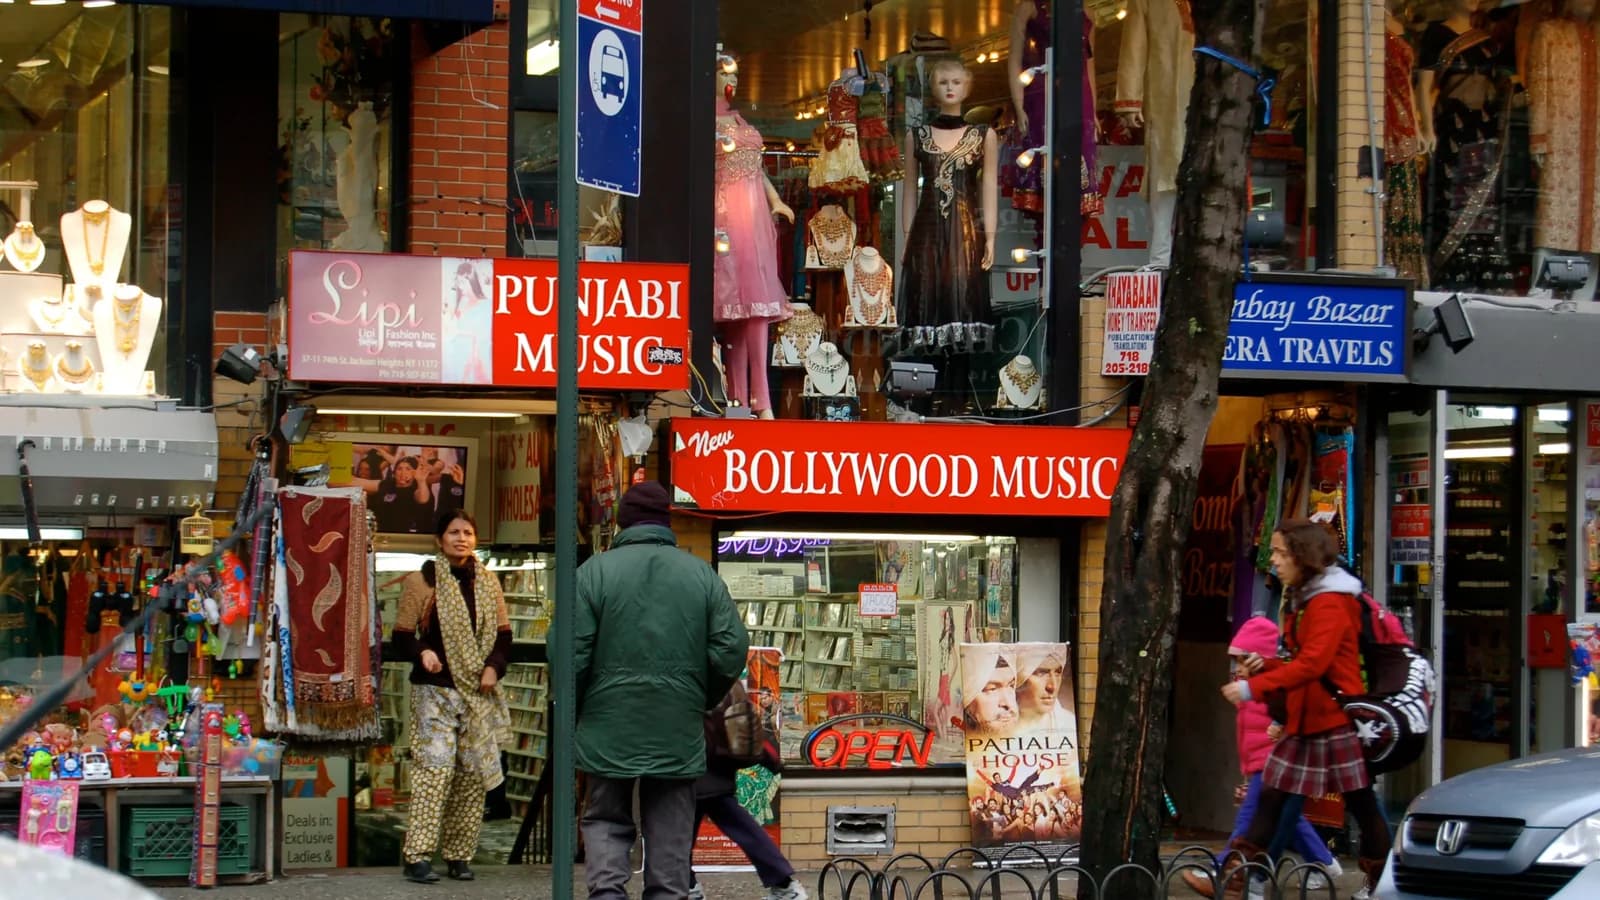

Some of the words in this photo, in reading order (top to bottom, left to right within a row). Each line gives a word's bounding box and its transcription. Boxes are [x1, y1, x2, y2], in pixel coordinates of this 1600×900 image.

[307, 259, 423, 355] Lipi
[1308, 295, 1394, 324] Bazar
[1126, 311, 1157, 332] TRANSFER
[386, 328, 420, 340] Fashion
[1108, 333, 1154, 341] PUBLICATIONS
[1120, 351, 1139, 361] 718
[1279, 337, 1394, 366] TRAVELS
[688, 430, 735, 457] New
[722, 448, 979, 498] BOLLYWOOD
[991, 455, 1118, 500] MUSIC
[810, 729, 936, 770] OPEN
[968, 736, 1074, 755] PATIALA
[982, 753, 1070, 769] HOUSE
[286, 813, 317, 828] Deals
[284, 831, 334, 845] Exclusive
[287, 850, 321, 863] Ladies
